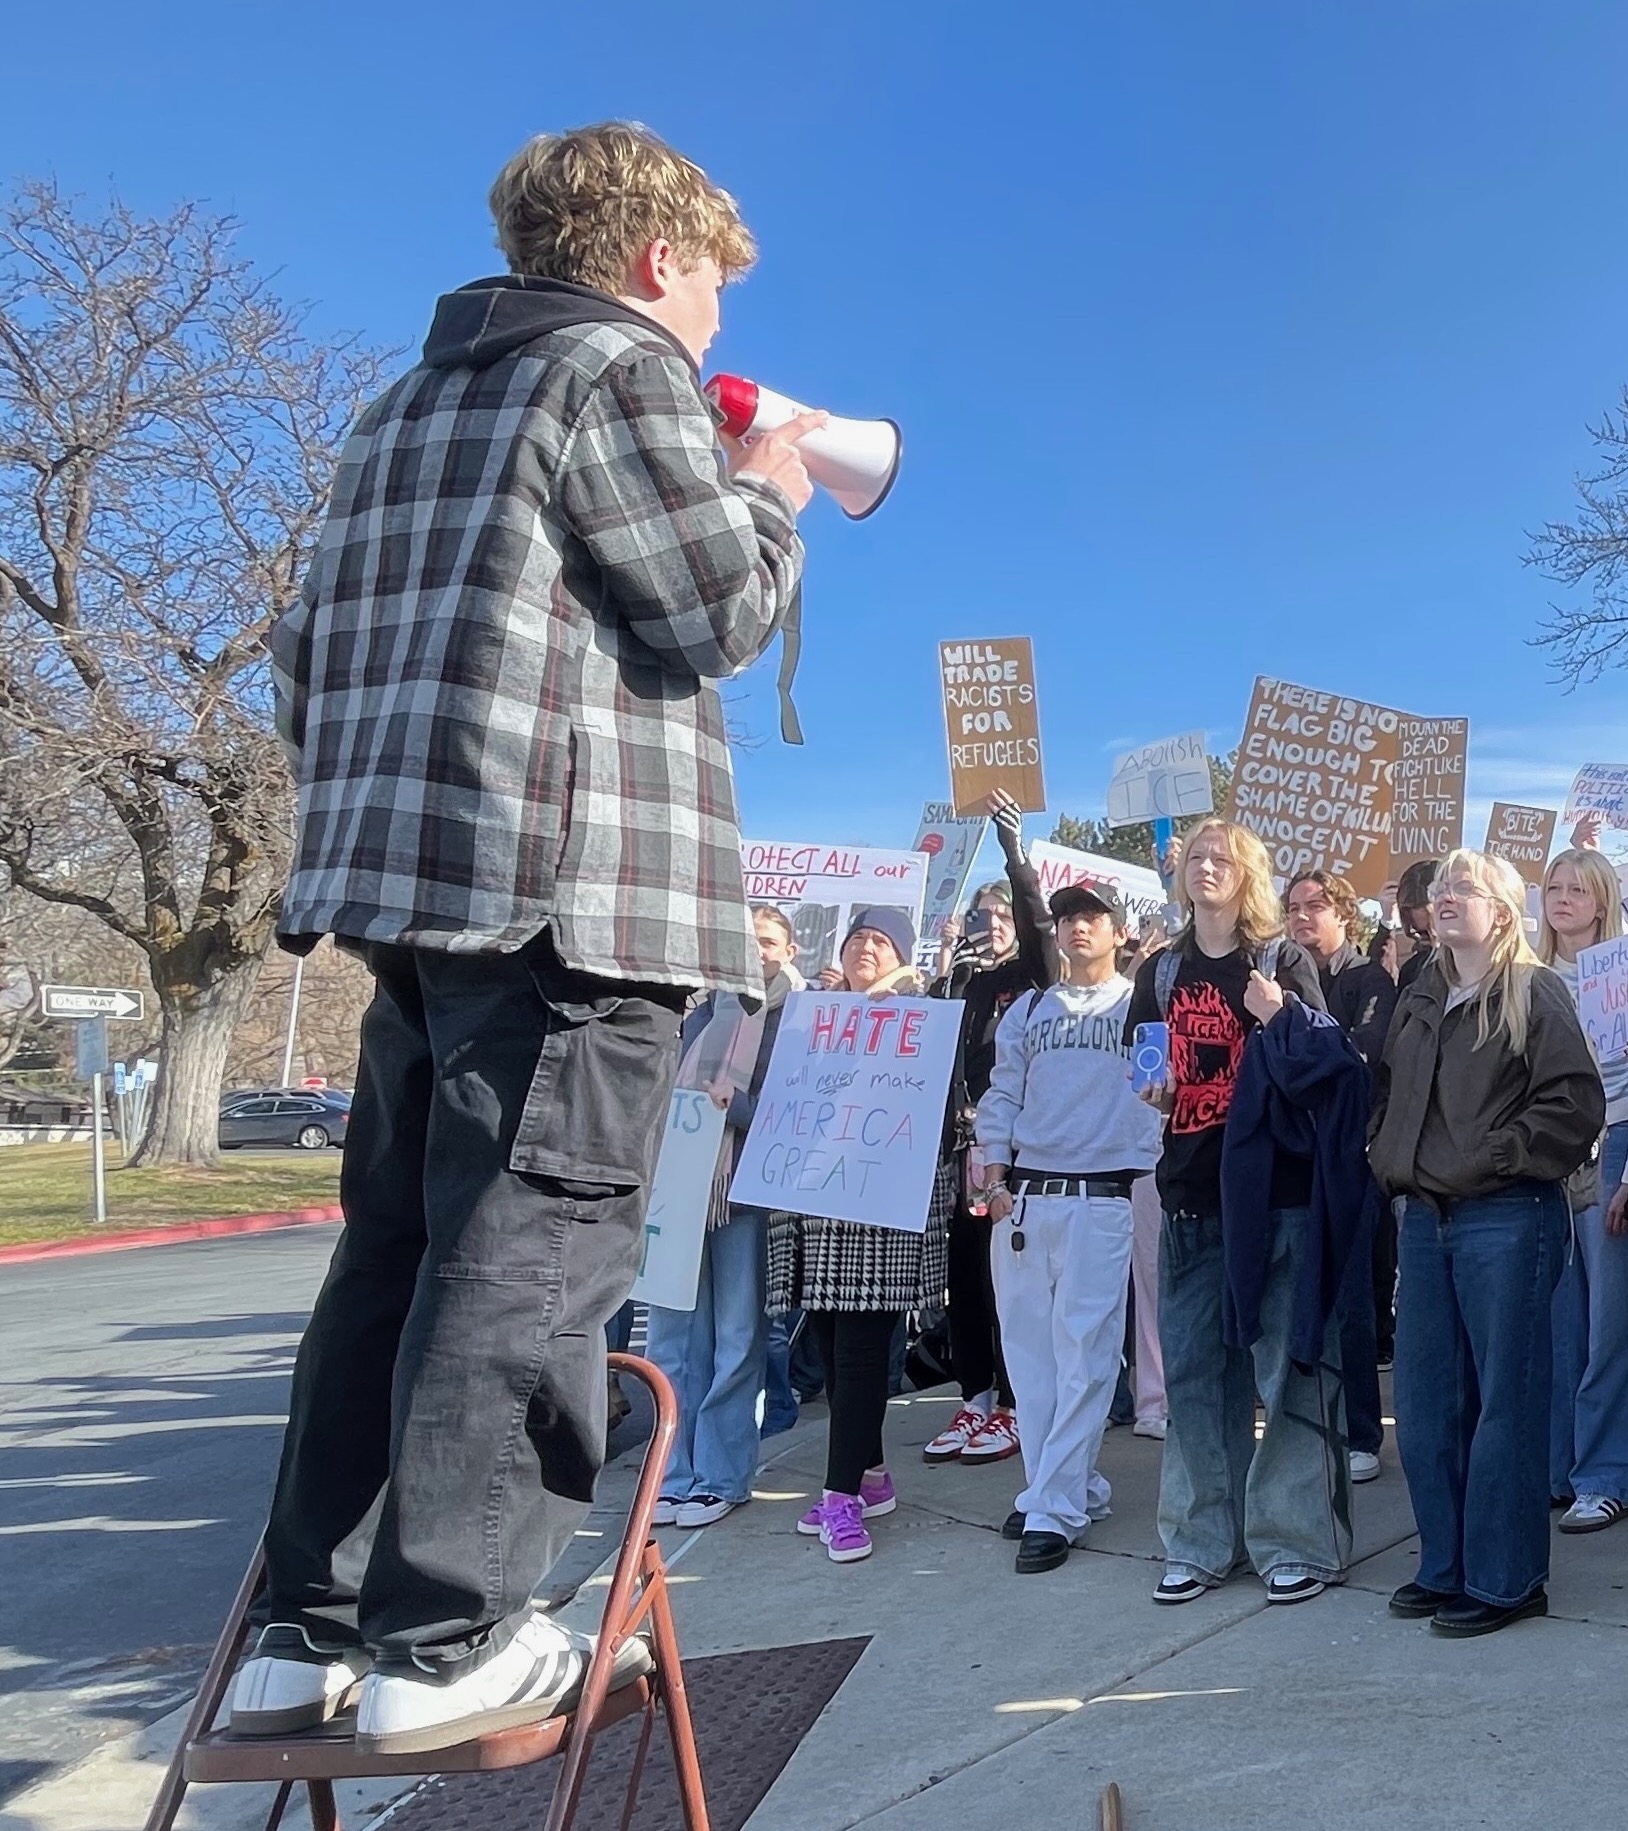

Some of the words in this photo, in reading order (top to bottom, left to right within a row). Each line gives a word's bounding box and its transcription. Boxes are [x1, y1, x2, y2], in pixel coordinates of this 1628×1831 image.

[944, 644, 1002, 665] WILL
[944, 660, 1019, 684] TRADE
[946, 683, 1034, 708] RACISTS
[1260, 678, 1333, 714] THERE
[1334, 698, 1358, 721] IS
[1359, 704, 1399, 734] NO
[962, 710, 1013, 735] FOR
[1253, 703, 1324, 737] FLAG
[1327, 719, 1378, 752] BIG
[1398, 721, 1440, 740] MOURN
[1441, 719, 1465, 735] THE
[951, 738, 1040, 769] REFUGEES
[1246, 733, 1361, 776] ENOUGH
[1402, 736, 1450, 758] DEAD
[1393, 757, 1434, 779] FIGHT
[1434, 754, 1463, 775] LIKE
[1112, 772, 1208, 821] ICE
[1242, 761, 1322, 796] COVER
[1328, 775, 1379, 806] THE
[1394, 777, 1452, 801] HELL
[1235, 784, 1309, 819] SHAME
[1310, 799, 1348, 825] OF
[1392, 801, 1418, 823] FOR
[1424, 800, 1457, 822] THE
[1235, 809, 1379, 862] INNOCENT
[1506, 813, 1537, 832] BITE
[1390, 826, 1449, 855] LIVING
[1488, 839, 1512, 860] THE
[1510, 844, 1544, 862] HAND
[823, 850, 862, 875] ALL
[874, 863, 911, 879] our
[56, 995, 82, 1005] ONE
[88, 998, 115, 1008] WAY
[807, 1003, 929, 1058] HATE
[816, 1069, 860, 1091] never
[758, 1100, 914, 1150] AMERICA
[762, 1142, 883, 1199] GREAT
